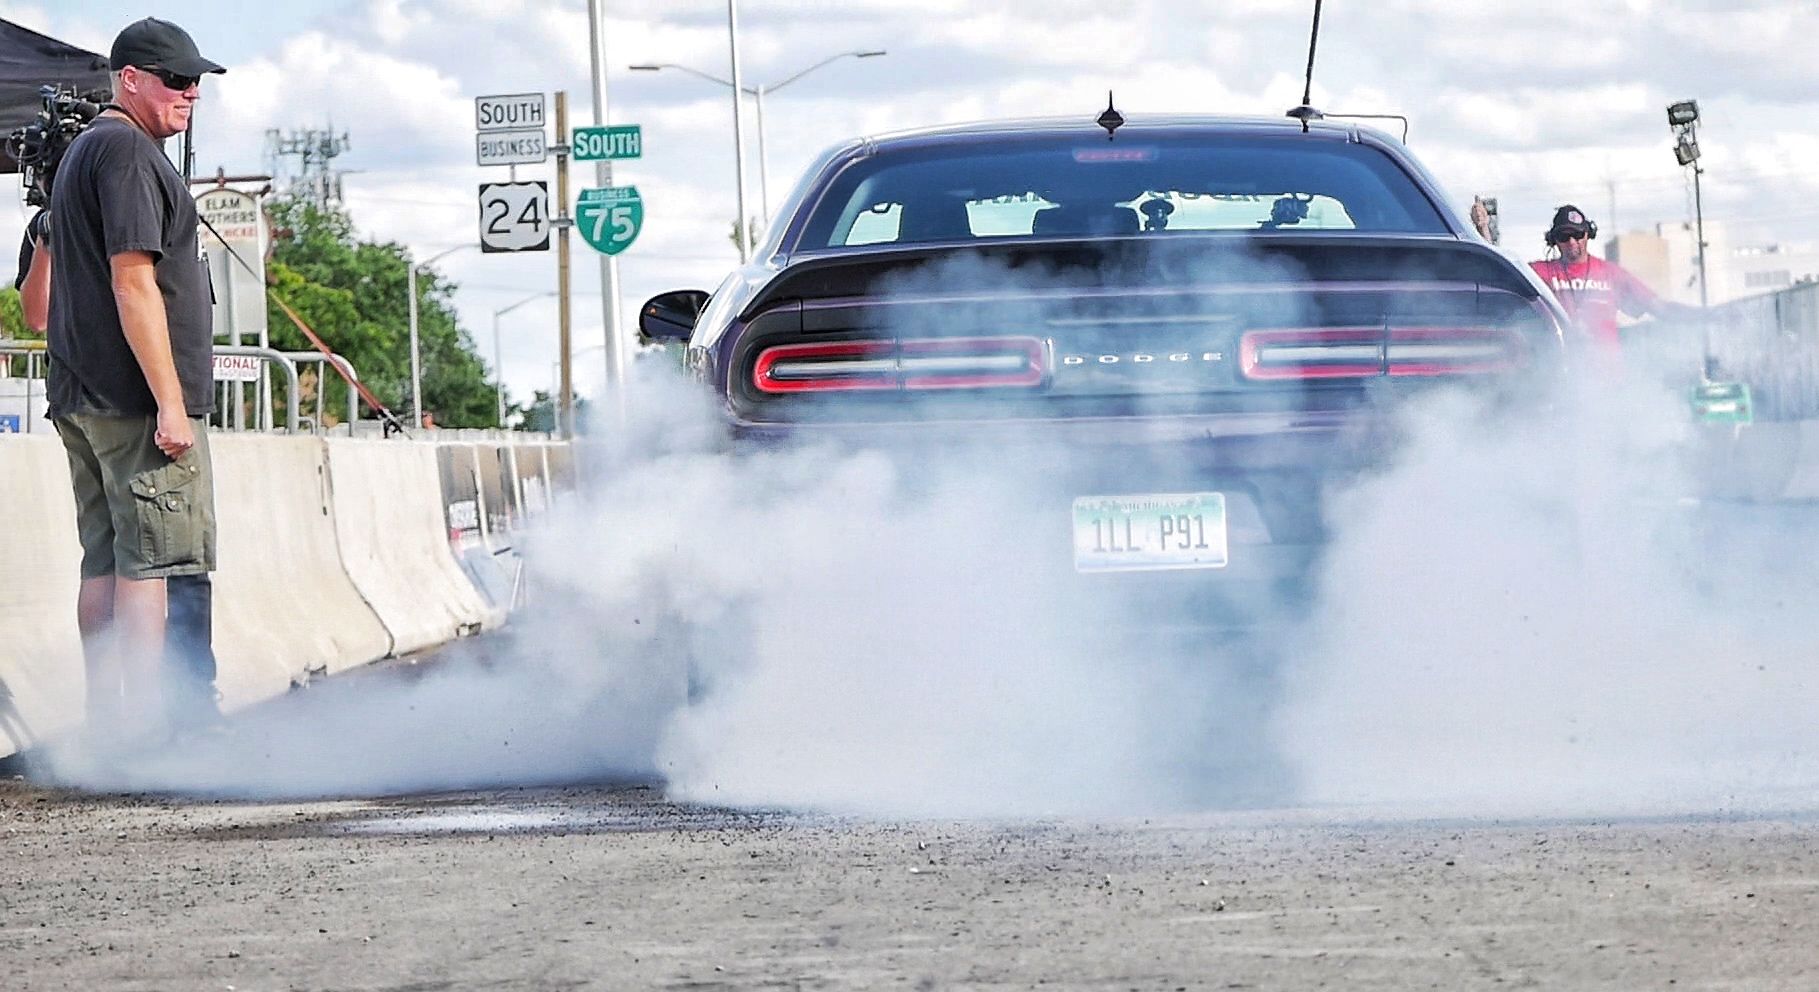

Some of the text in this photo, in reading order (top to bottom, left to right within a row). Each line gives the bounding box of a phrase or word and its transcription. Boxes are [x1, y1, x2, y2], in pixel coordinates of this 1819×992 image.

[480, 102, 541, 124] SOUTH
[481, 138, 541, 157] BUSINESS
[575, 132, 639, 157] SOUTH
[487, 197, 542, 234] 24
[585, 207, 635, 242] 75
[1063, 352, 1223, 365] DODGE
[1160, 513, 1209, 551] P91
